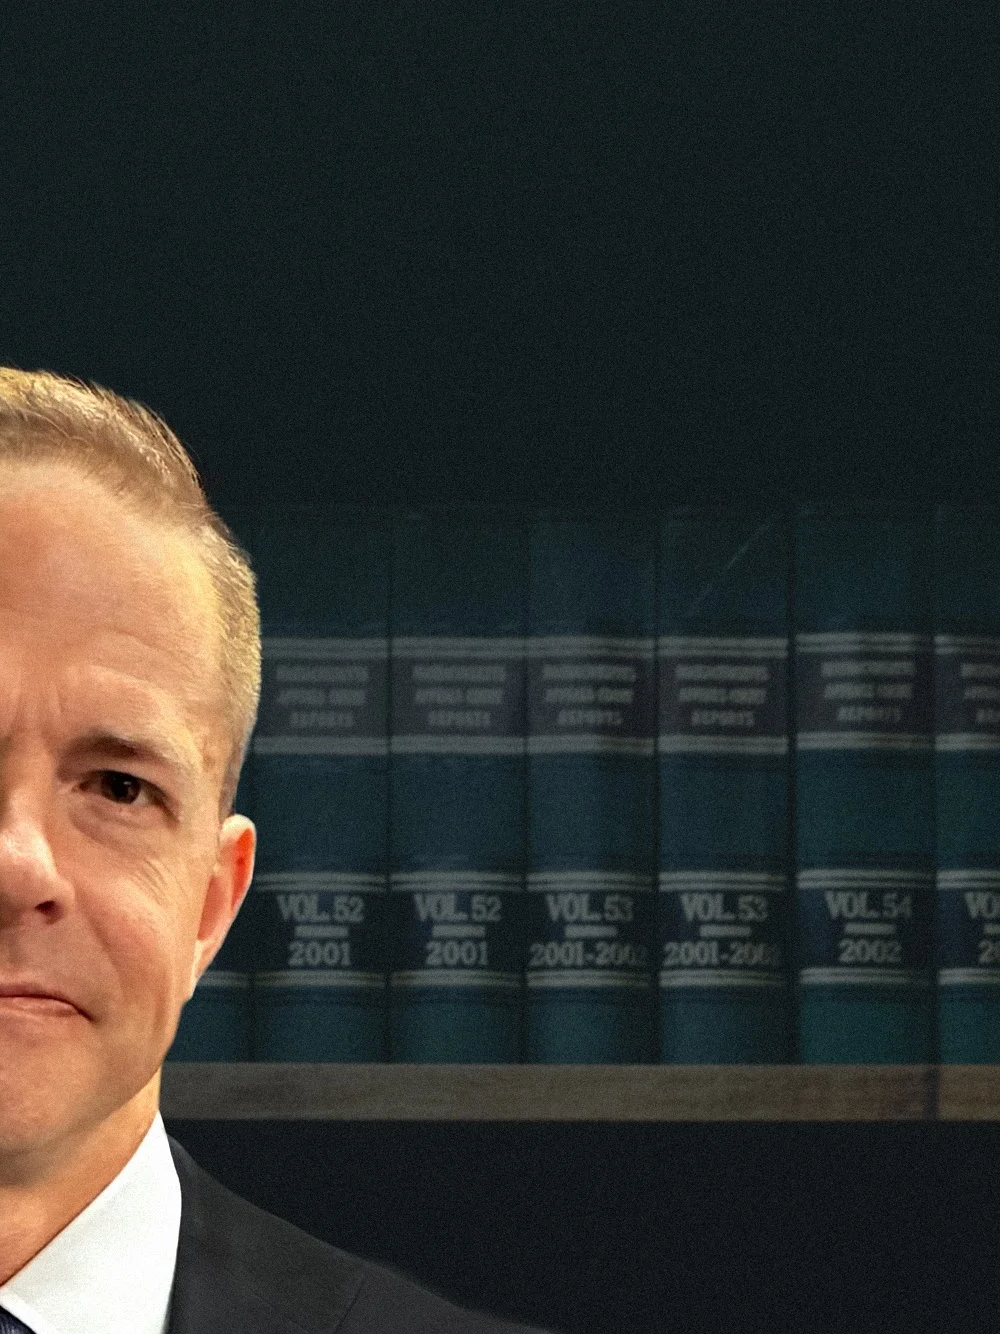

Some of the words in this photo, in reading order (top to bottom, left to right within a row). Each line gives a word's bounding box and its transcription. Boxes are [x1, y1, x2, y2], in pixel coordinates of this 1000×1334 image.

[277, 893, 330, 923] VOL.
[333, 895, 366, 923] 52
[413, 893, 468, 923] VOL.
[471, 894, 503, 923] 52
[546, 893, 602, 923] VOL.
[604, 894, 634, 923] 53
[680, 893, 736, 923] VOL.
[738, 894, 769, 923] 53
[824, 890, 880, 920] VOL.
[882, 891, 914, 919] 54
[287, 941, 352, 967] 2001
[425, 941, 490, 967] 2001
[837, 939, 903, 964] 2002
